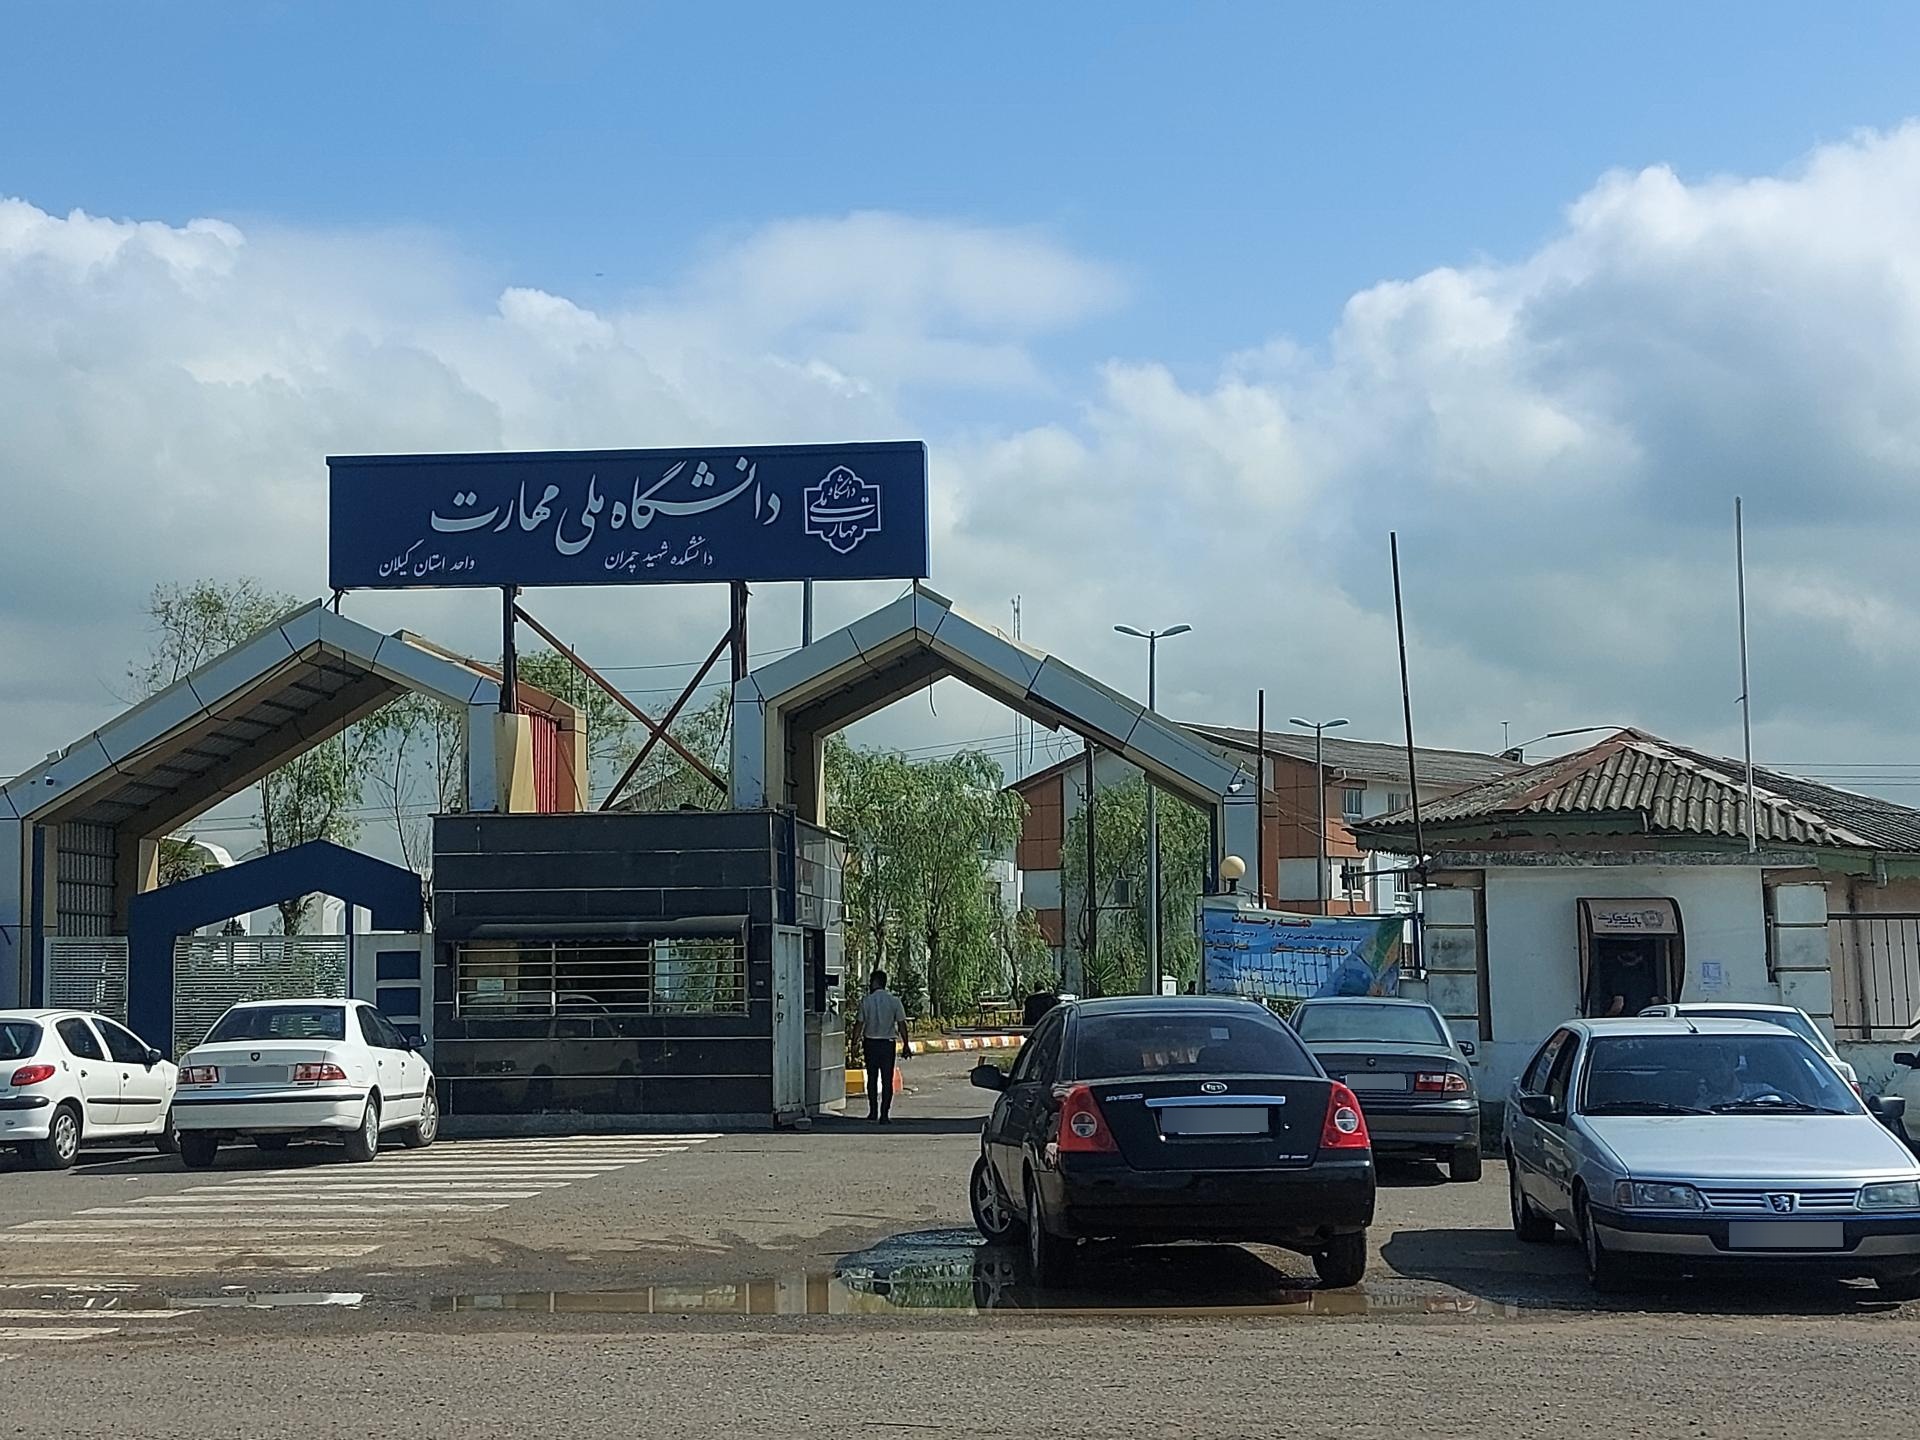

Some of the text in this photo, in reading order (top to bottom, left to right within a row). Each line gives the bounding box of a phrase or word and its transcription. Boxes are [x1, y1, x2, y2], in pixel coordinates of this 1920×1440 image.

[827, 473, 856, 500] دانشگاه
[430, 456, 782, 556] دانشگاه ملی مهارت
[413, 553, 446, 577] استان
[449, 555, 476, 571] واحد
[604, 535, 714, 574] دانشکده شهید چمران
[1231, 911, 1276, 930] وحدت
